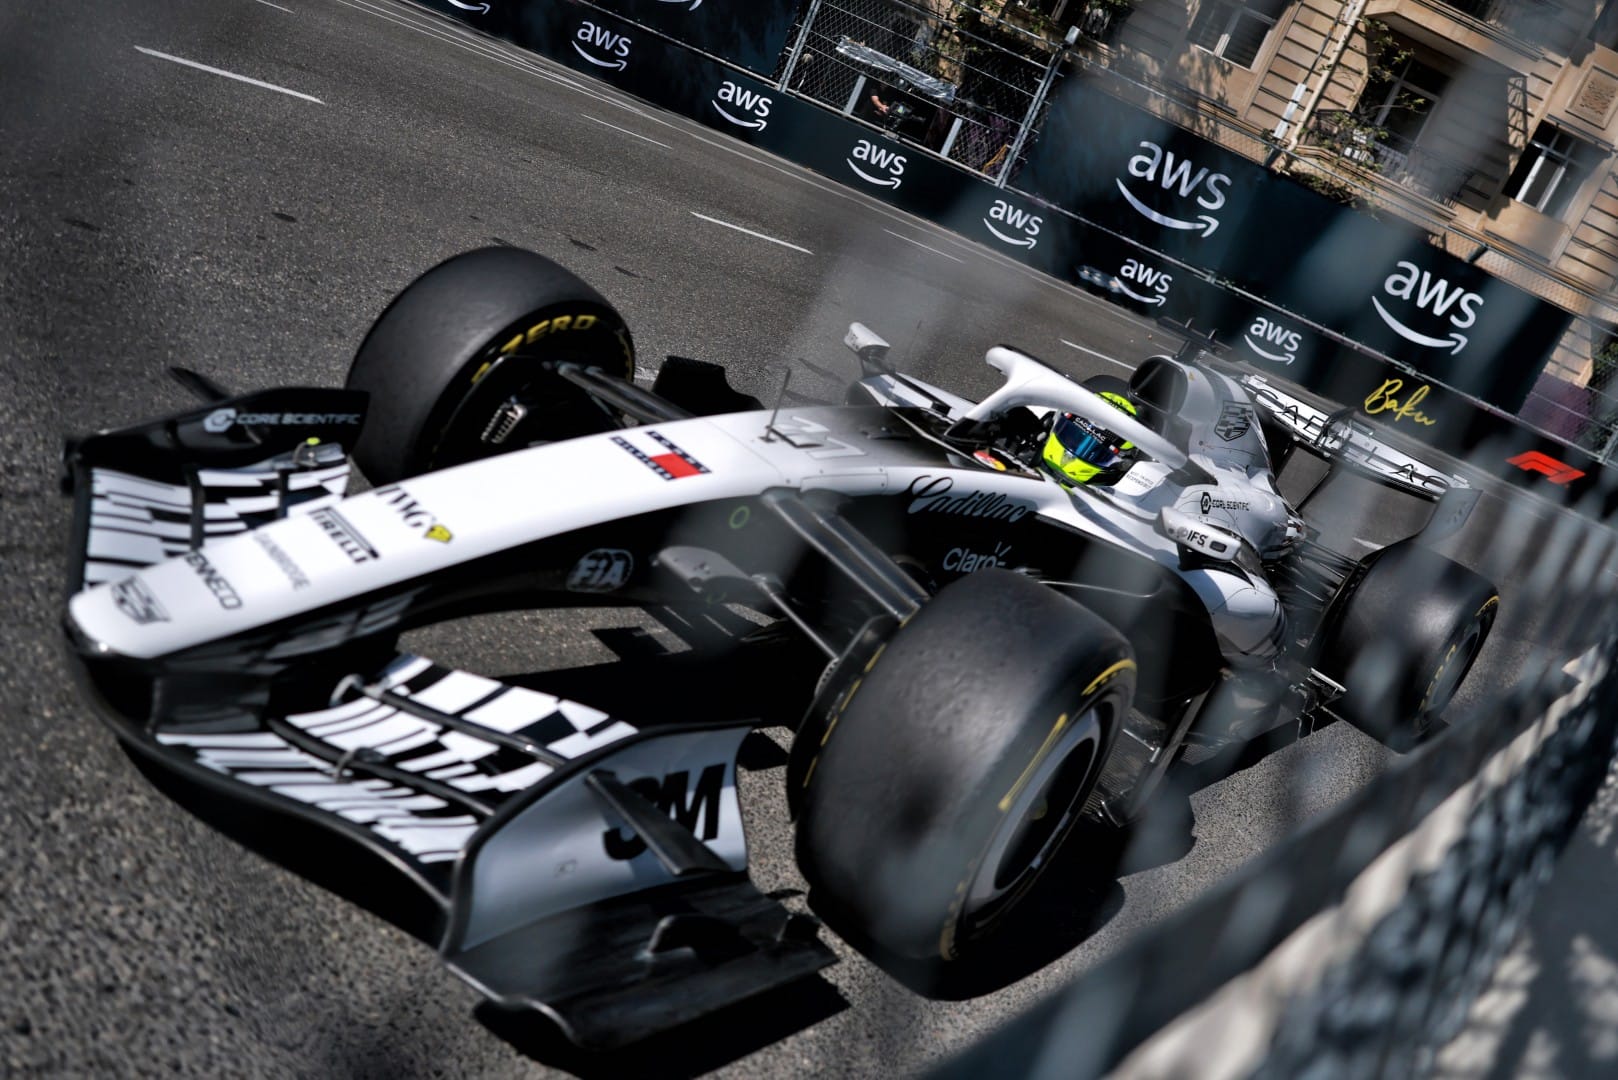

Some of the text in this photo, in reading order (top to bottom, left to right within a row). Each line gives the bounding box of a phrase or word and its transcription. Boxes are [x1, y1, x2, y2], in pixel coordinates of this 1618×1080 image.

[577, 21, 632, 57] aws
[718, 81, 772, 117] aws
[852, 139, 907, 176] aws
[1127, 140, 1232, 210] aws
[989, 199, 1043, 236] aws
[1120, 258, 1173, 294] aws
[1384, 260, 1484, 329] aws
[1250, 316, 1302, 352] aws
[236, 413, 280, 425] CORE
[1364, 378, 1437, 426] Baku
[904, 474, 1040, 523] Cadillac
[1187, 530, 1209, 546] IFS
[943, 547, 998, 573] Claro
